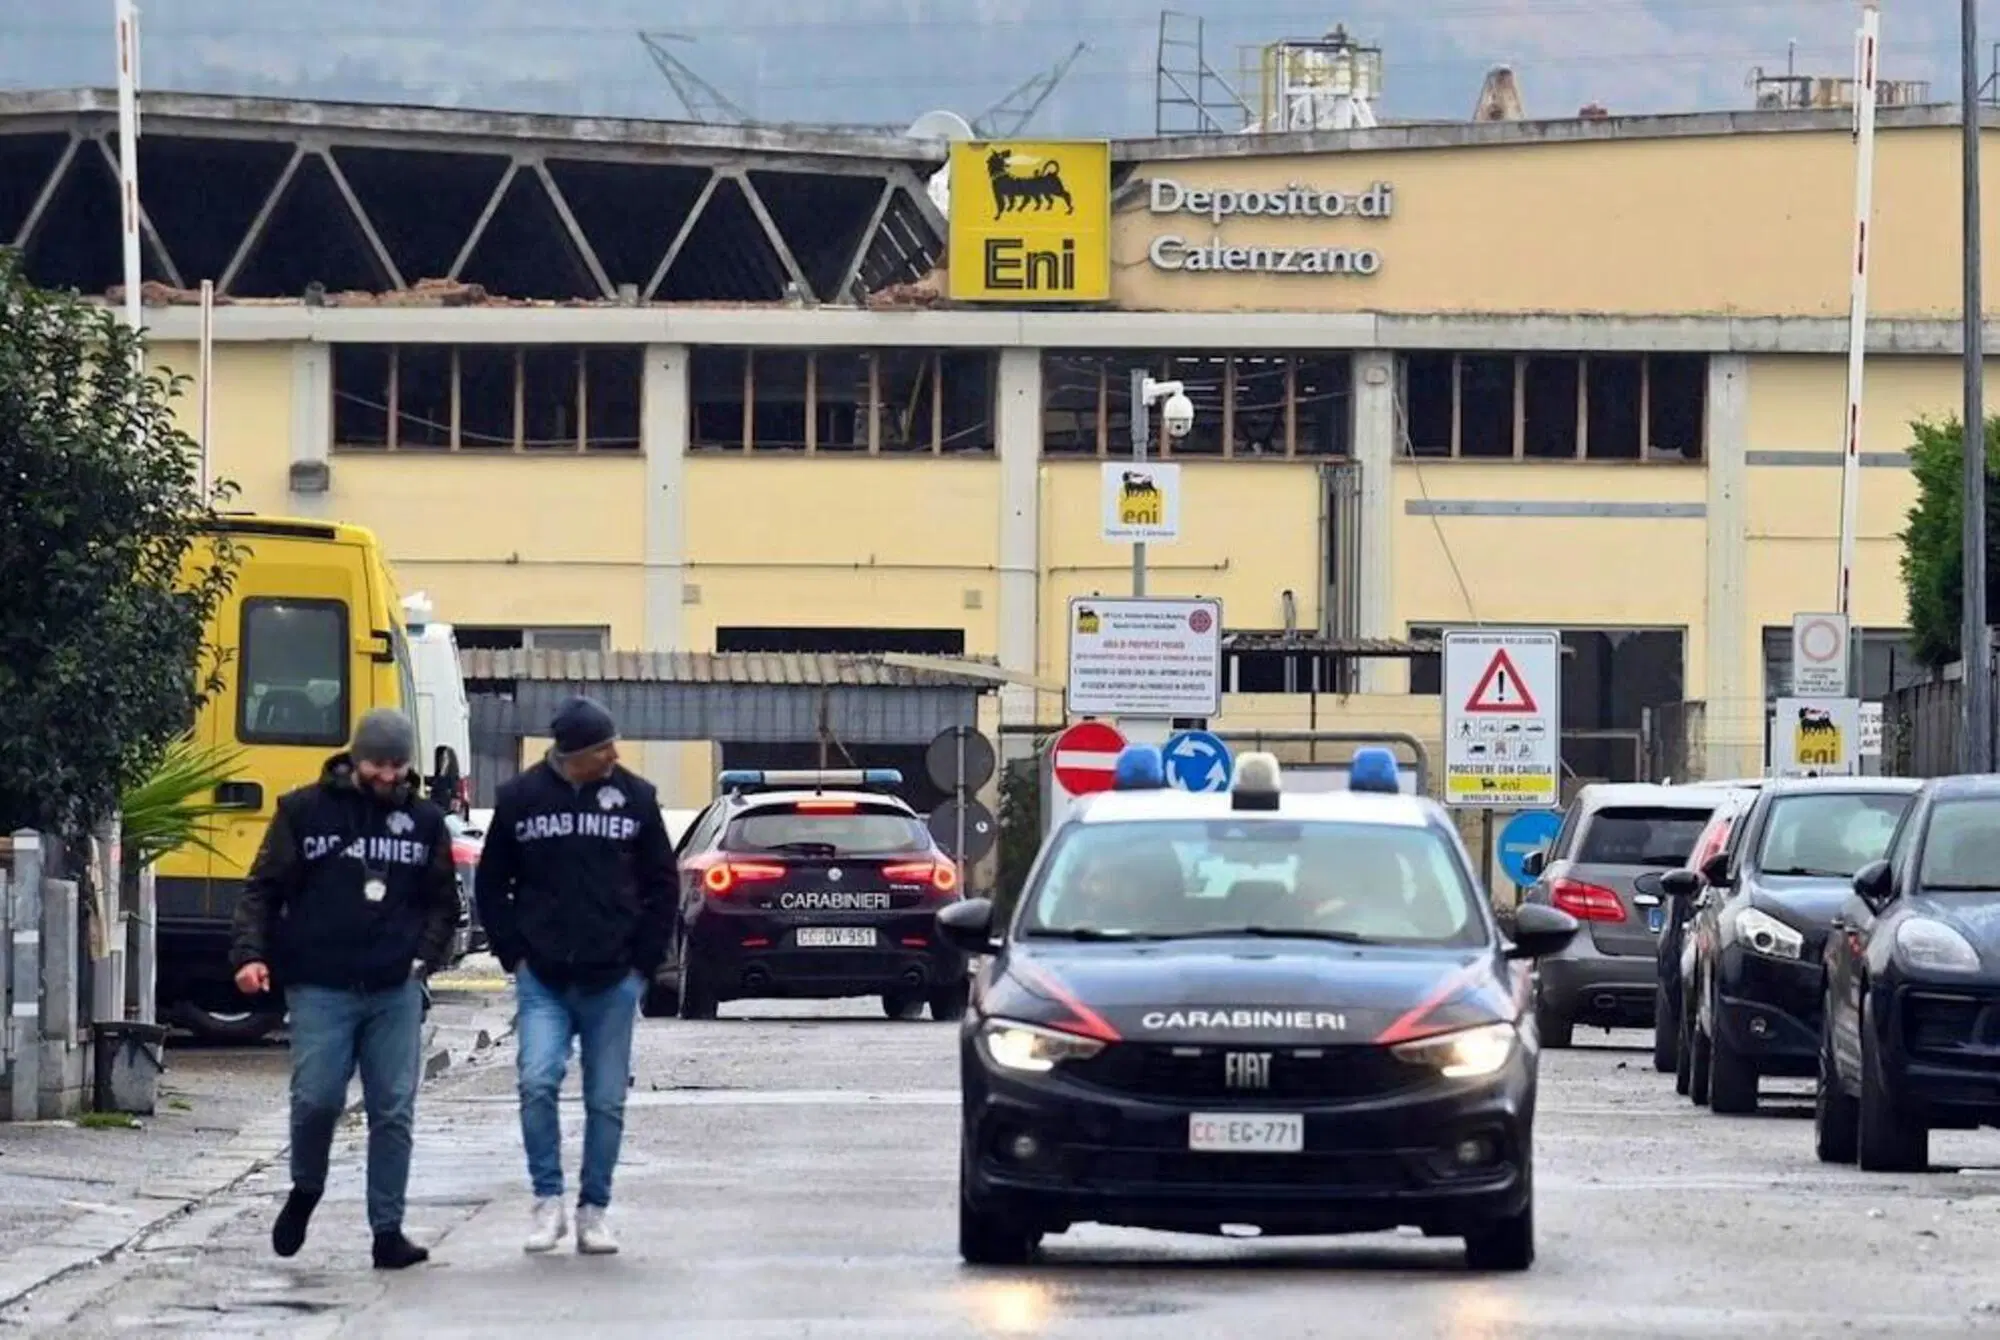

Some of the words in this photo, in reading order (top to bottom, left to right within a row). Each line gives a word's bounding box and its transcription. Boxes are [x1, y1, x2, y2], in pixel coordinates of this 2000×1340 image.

[1150, 178, 1345, 224] Deposito
[1356, 183, 1393, 217] di
[985, 239, 1075, 290] Eni
[1150, 234, 1381, 275] Calenzano
[1123, 503, 1158, 524] eni
[1800, 742, 1836, 764] eni
[780, 893, 891, 909] CARABINIERI
[1142, 1010, 1347, 1031] CARABINIERI
[1225, 1052, 1273, 1088] FIAT
